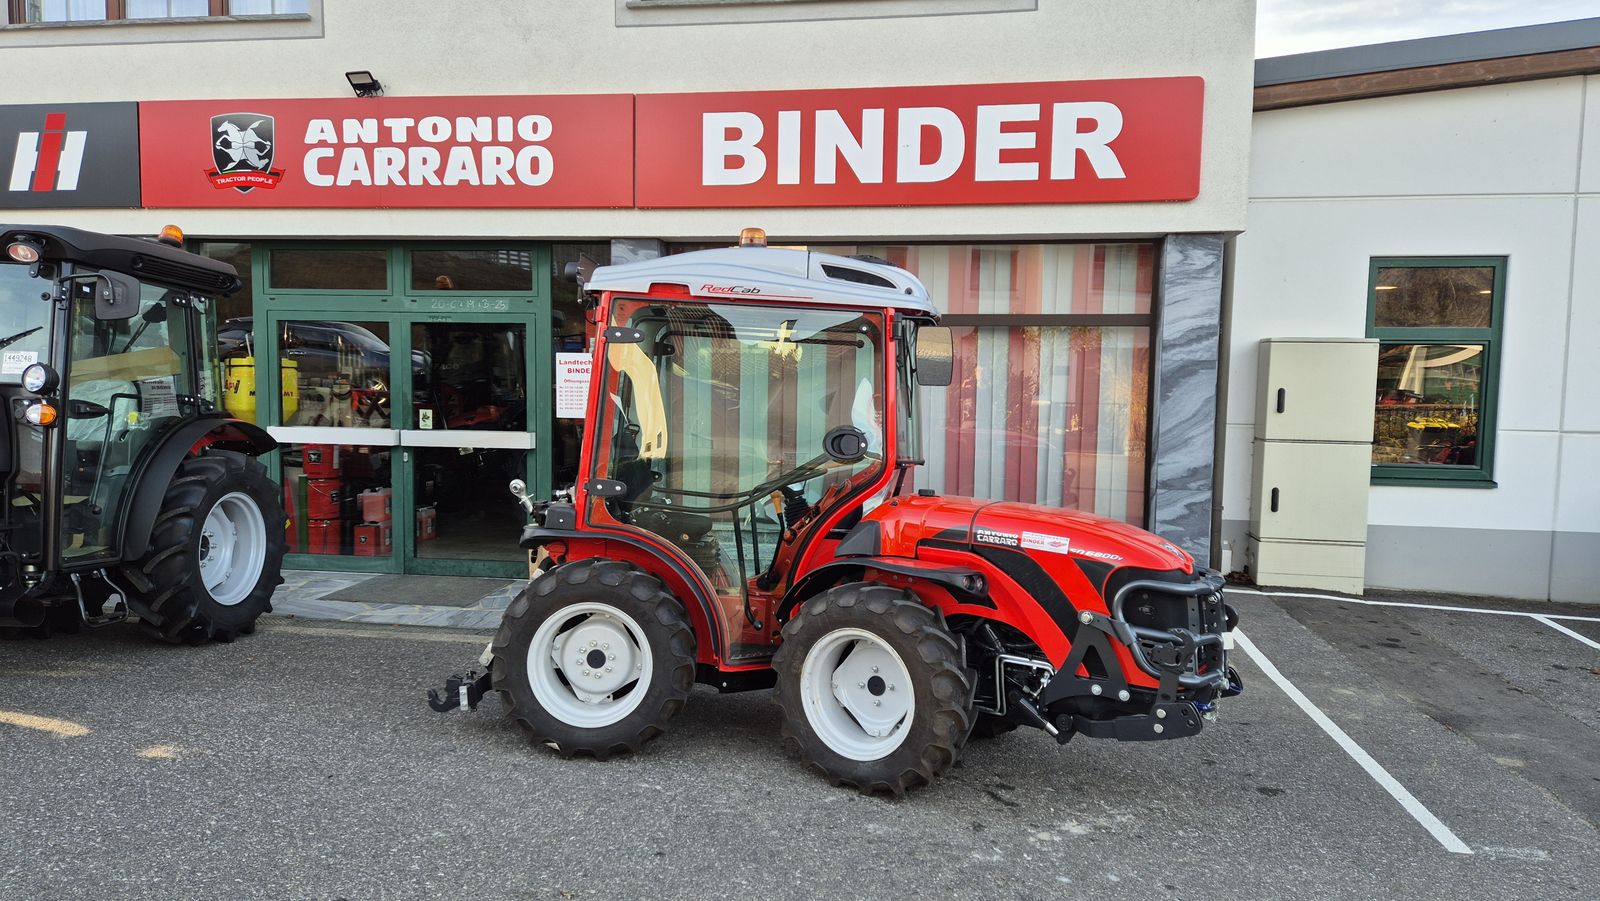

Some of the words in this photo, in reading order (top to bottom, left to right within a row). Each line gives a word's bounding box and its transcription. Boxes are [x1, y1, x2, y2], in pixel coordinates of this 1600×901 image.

[304, 115, 553, 144] ANTONIO
[702, 101, 1127, 186] BINDER
[303, 145, 554, 186] CARRARO
[216, 176, 246, 184] TRACTOR
[247, 176, 273, 184] PEOPLE
[701, 284, 761, 294] RedCab
[976, 529, 1019, 538] ANTONIO
[976, 534, 1018, 546] CARRARO
